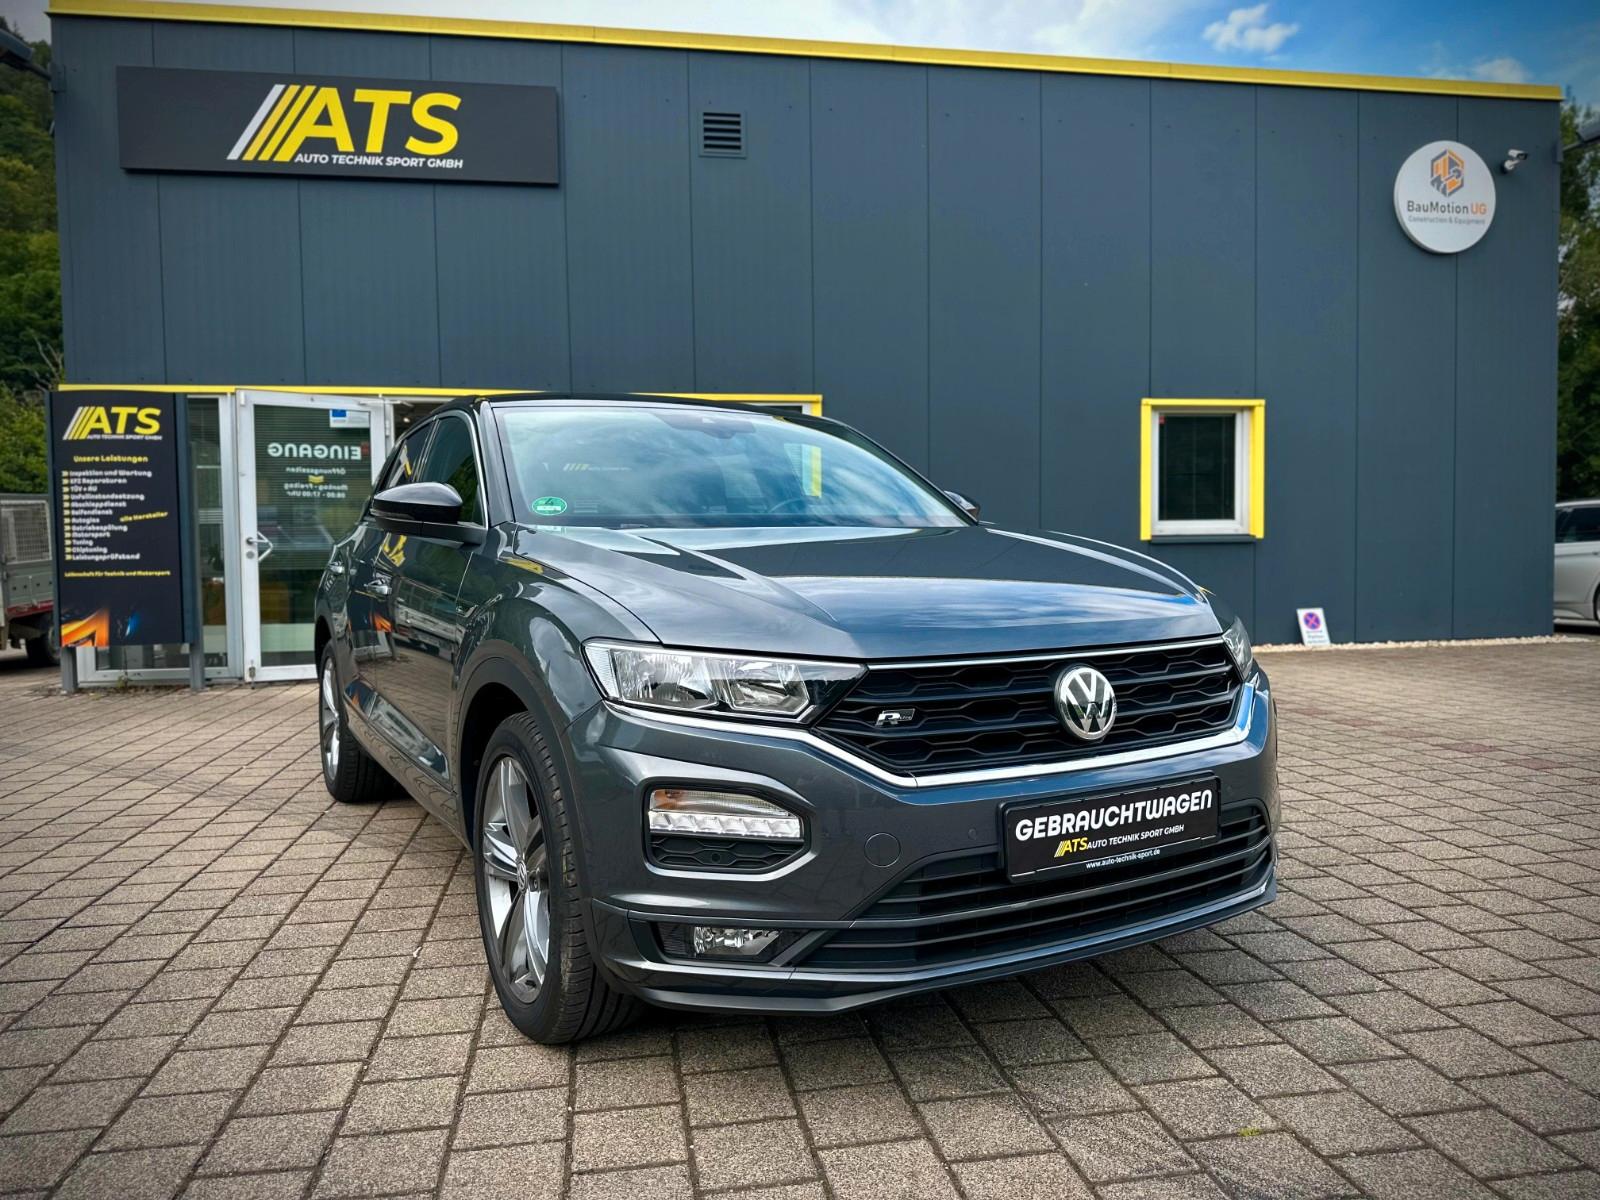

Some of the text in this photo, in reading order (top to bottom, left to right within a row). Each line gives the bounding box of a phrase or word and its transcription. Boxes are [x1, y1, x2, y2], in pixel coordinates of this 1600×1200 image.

[272, 87, 462, 162] ATS
[294, 153, 463, 169] AUTO TECHNIK SPORT GMBH
[1407, 200, 1488, 215] BauMotion UG
[79, 406, 162, 440] ATS
[101, 455, 148, 463] Leistungen
[1015, 789, 1213, 841] GEBRAUCHTWAGEN
[1060, 824, 1185, 857] ATS AUTO TECHNIK SPORT GMBH
[1085, 848, 1161, 870] www.auto-technik-sport.de
